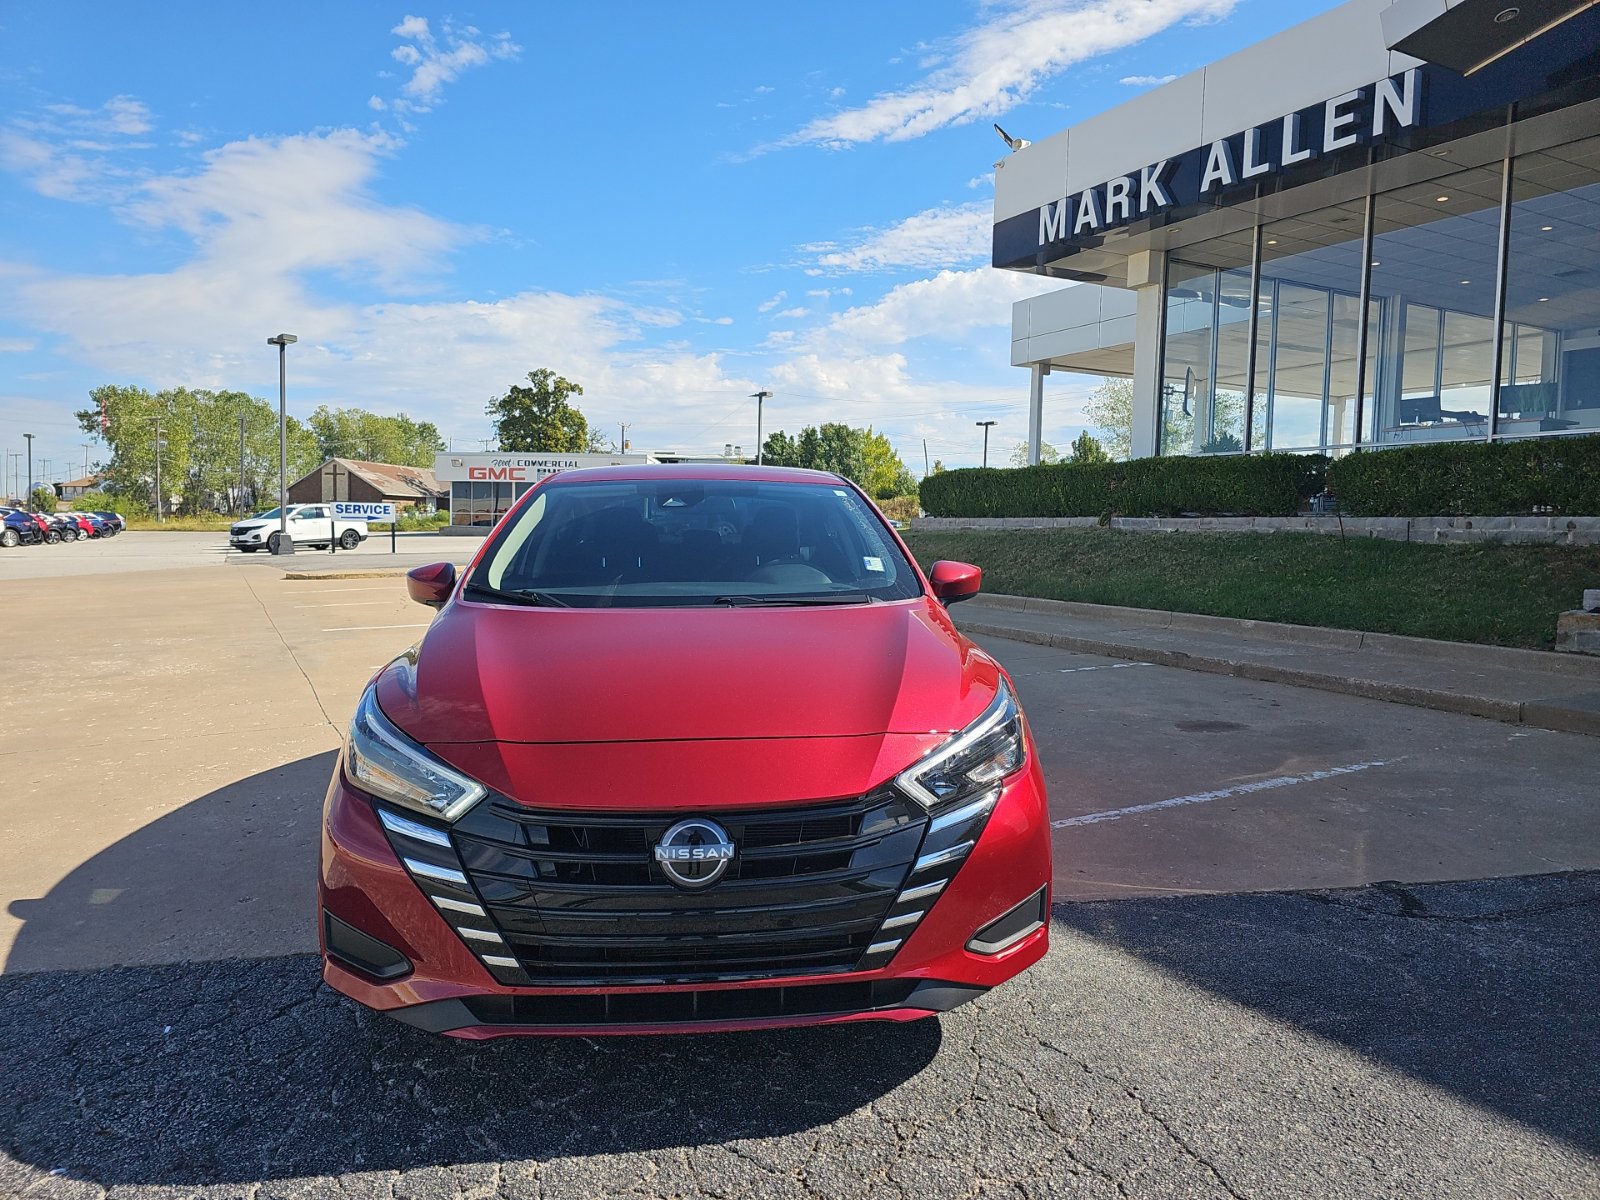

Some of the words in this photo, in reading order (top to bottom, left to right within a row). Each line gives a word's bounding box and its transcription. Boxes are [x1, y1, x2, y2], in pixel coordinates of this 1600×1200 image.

[1038, 160, 1174, 246] MARK
[1200, 68, 1422, 193] ALLEN
[517, 459, 579, 468] COMMERCIAL
[468, 467, 526, 481] GMC
[335, 503, 391, 515] SERVICE
[657, 846, 733, 859] NISSAN
